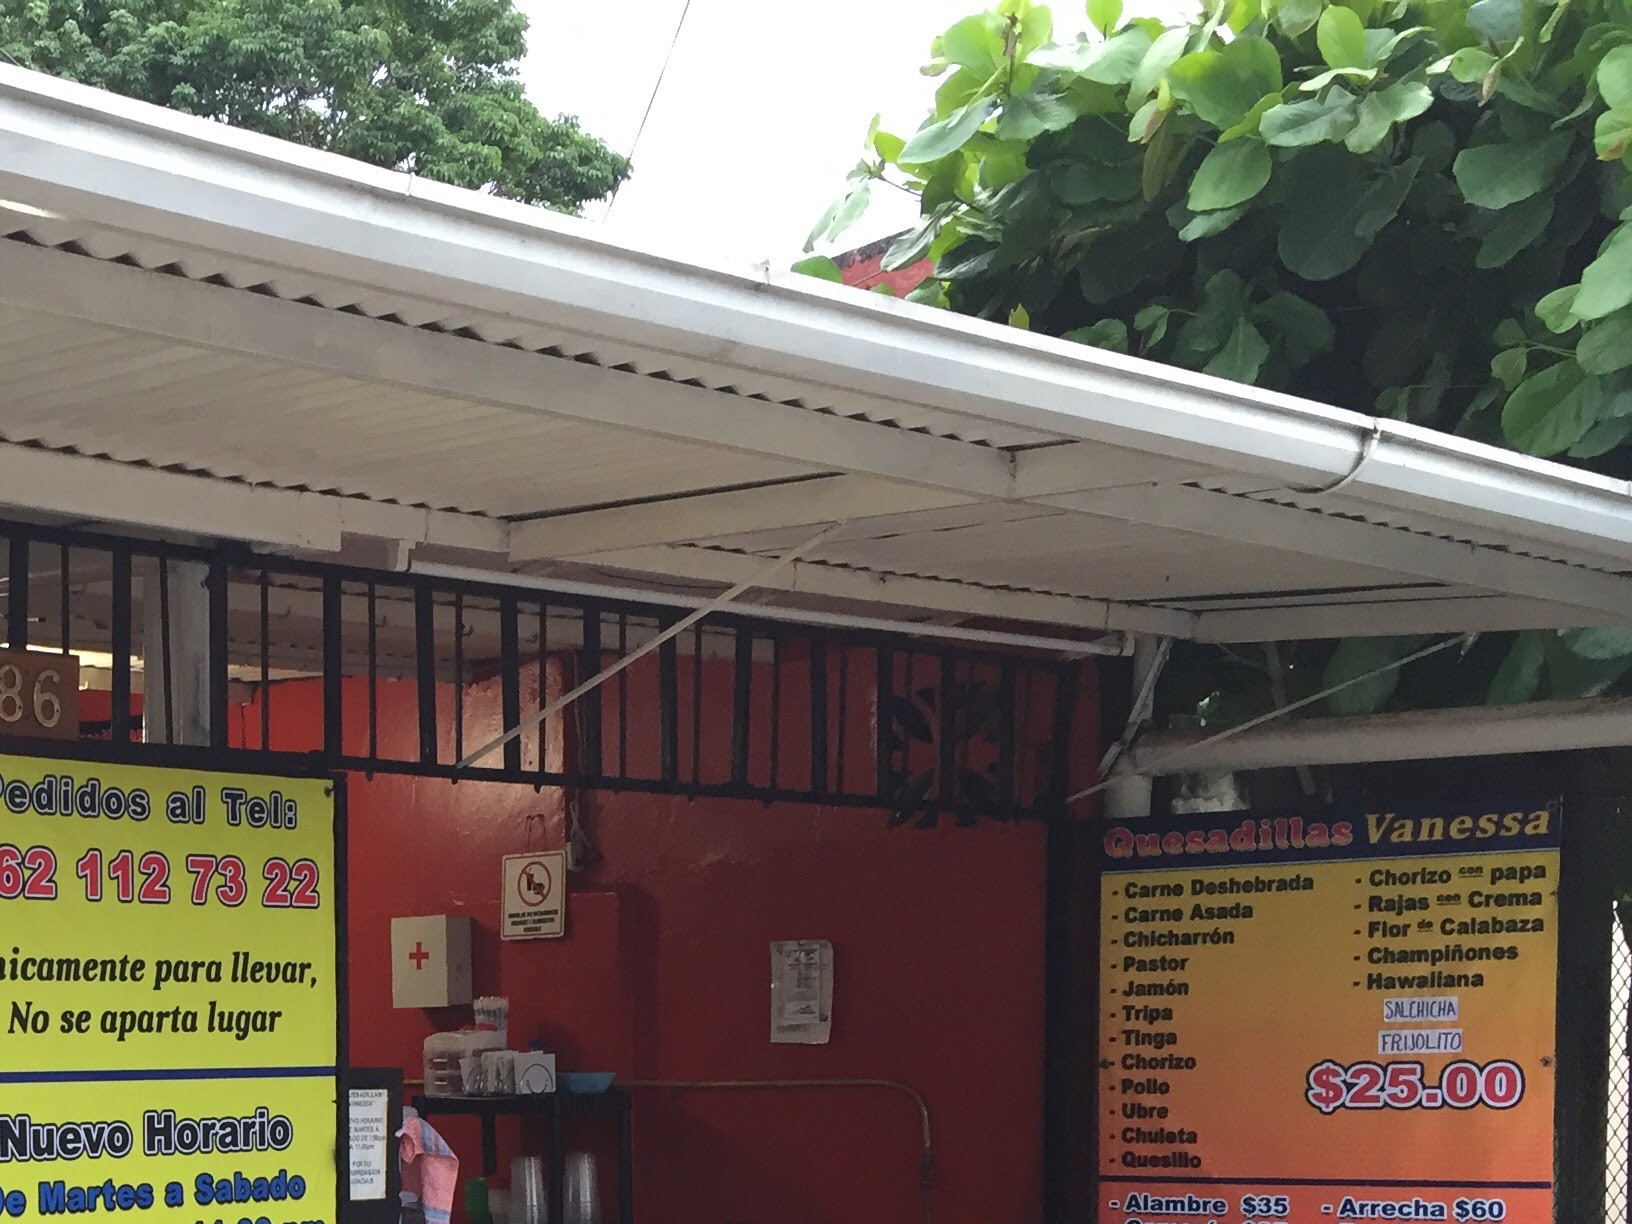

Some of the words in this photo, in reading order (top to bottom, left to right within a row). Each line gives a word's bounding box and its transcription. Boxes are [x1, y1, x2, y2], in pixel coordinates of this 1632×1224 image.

[166, 785, 205, 825] al
[222, 788, 298, 830] Tel:
[1103, 816, 1354, 860] Quesadillas
[1365, 809, 1551, 845] Vanessa
[76, 848, 170, 905] 112
[185, 853, 248, 907] 73
[262, 857, 321, 909] 22
[1124, 881, 1184, 899] Carne
[1191, 874, 1314, 896] Deshebrada
[1369, 867, 1452, 887] Chorizo
[1458, 866, 1484, 878] con
[1490, 865, 1547, 886] papa
[1123, 906, 1184, 923] Carne
[1189, 902, 1254, 921] Asada
[1368, 894, 1430, 916] Rajas
[1436, 893, 1462, 906] con
[1468, 891, 1543, 908] Crema
[1123, 927, 1235, 948] Chicharrón
[1367, 920, 1412, 939] Flor
[1417, 919, 1434, 932] de
[1439, 916, 1545, 936] Calabaza
[1123, 955, 1190, 973] Pastor
[1367, 944, 1519, 966] Champiñones
[152, 959, 222, 991] para
[230, 952, 318, 988] llevar,
[1122, 979, 1189, 997] Jamón
[1121, 1004, 1174, 1026] Tripa
[1384, 1000, 1456, 1020] SALCHICHA
[7, 1001, 50, 1034] No
[60, 1010, 91, 1034] se
[100, 1005, 199, 1042] aparta
[207, 1001, 282, 1041] lugar
[1120, 1029, 1178, 1050] Tinga
[1380, 1032, 1462, 1052] FRIJOLITO
[1120, 1053, 1197, 1070] Chorizo
[1121, 1078, 1171, 1095] Pollo
[1306, 1059, 1526, 1115] $25.00
[1121, 1102, 1169, 1120] Ubre
[143, 1107, 293, 1156] Horario
[1121, 1126, 1198, 1144] Chuleta
[1121, 1151, 1202, 1168] Quesillo
[38, 1177, 155, 1217] Martes
[165, 1179, 185, 1206] a
[194, 1168, 306, 1206] Sabado
[1124, 1193, 1228, 1215] Alambre
[1240, 1194, 1291, 1218] $35
[1337, 1195, 1448, 1220] Arrecha
[1453, 1197, 1507, 1222] $60
